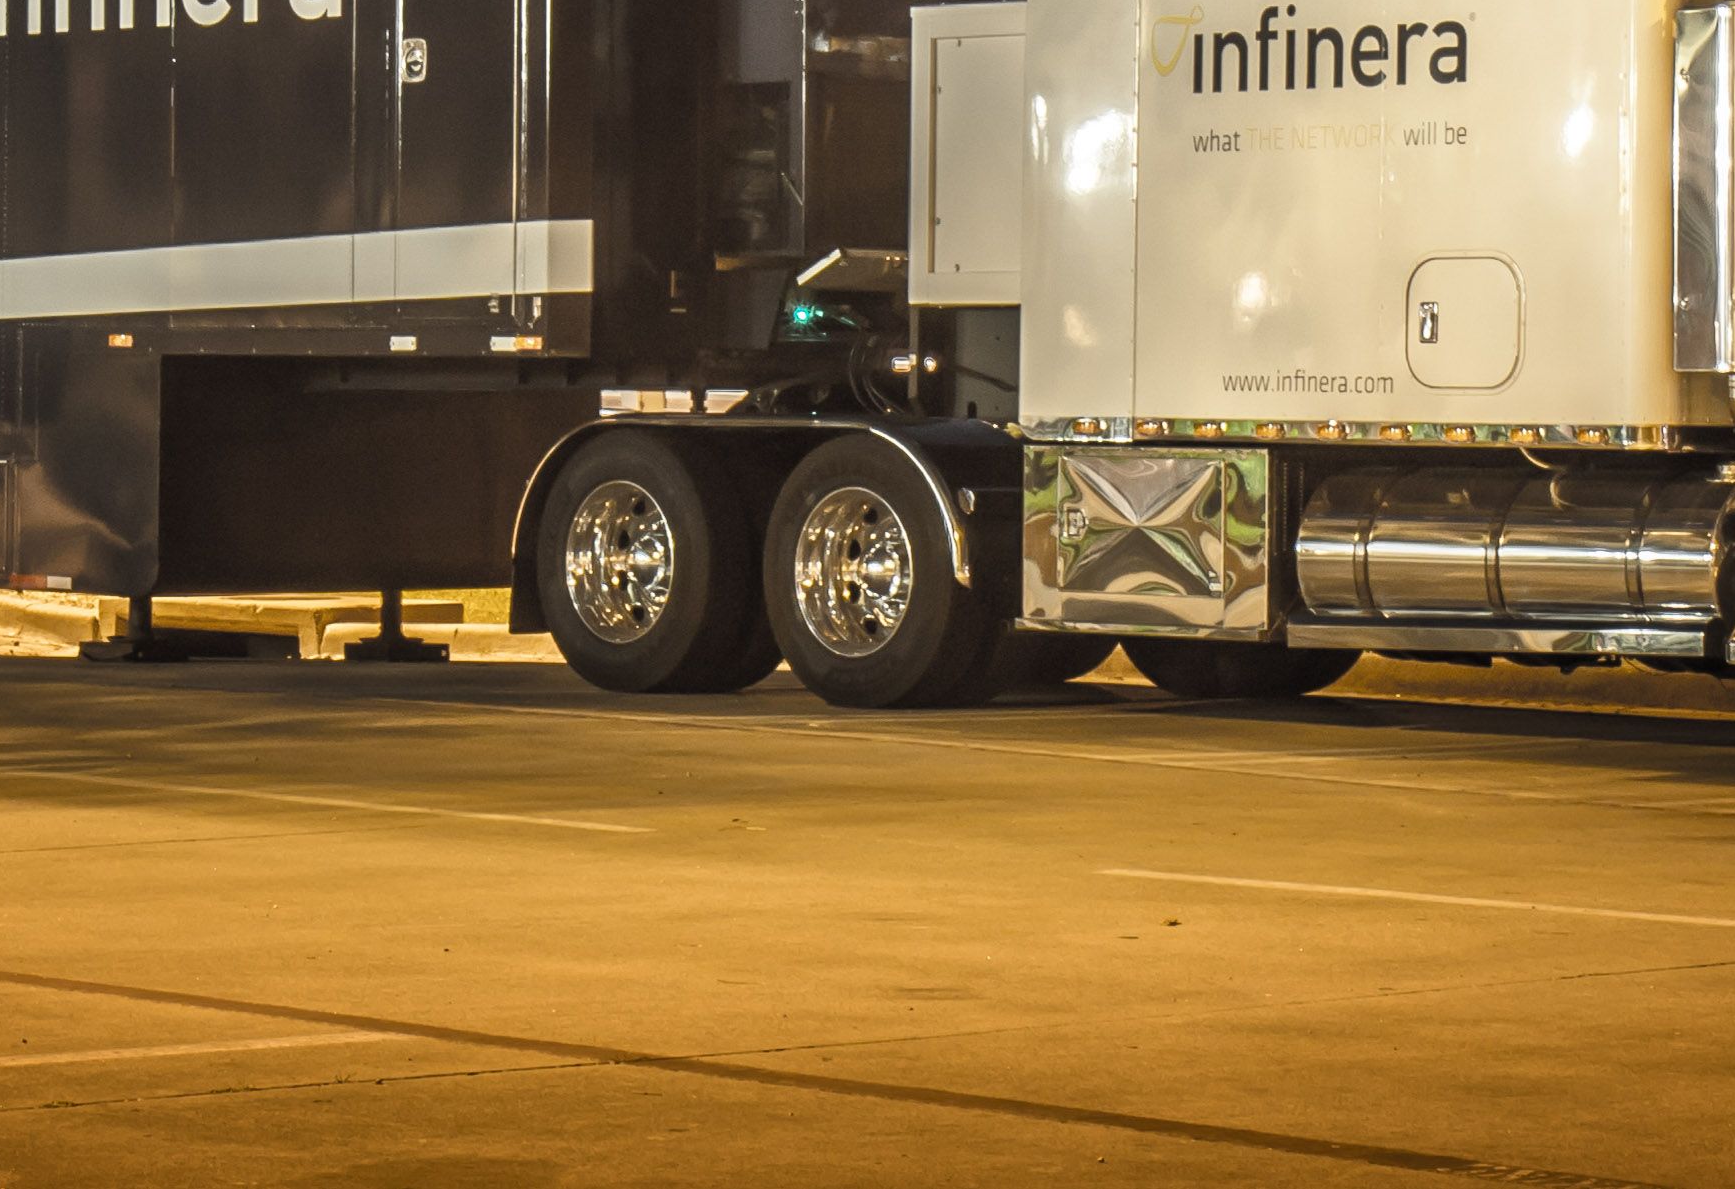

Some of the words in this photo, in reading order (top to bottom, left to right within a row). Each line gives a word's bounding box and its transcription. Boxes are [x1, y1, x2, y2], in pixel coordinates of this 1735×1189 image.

[1192, 129, 1241, 153] what
[1246, 126, 1285, 150] THE
[1288, 123, 1395, 149] NETWORK
[1403, 121, 1437, 147] will
[1444, 121, 1467, 145] be
[1222, 369, 1394, 394] www.infinera.com
